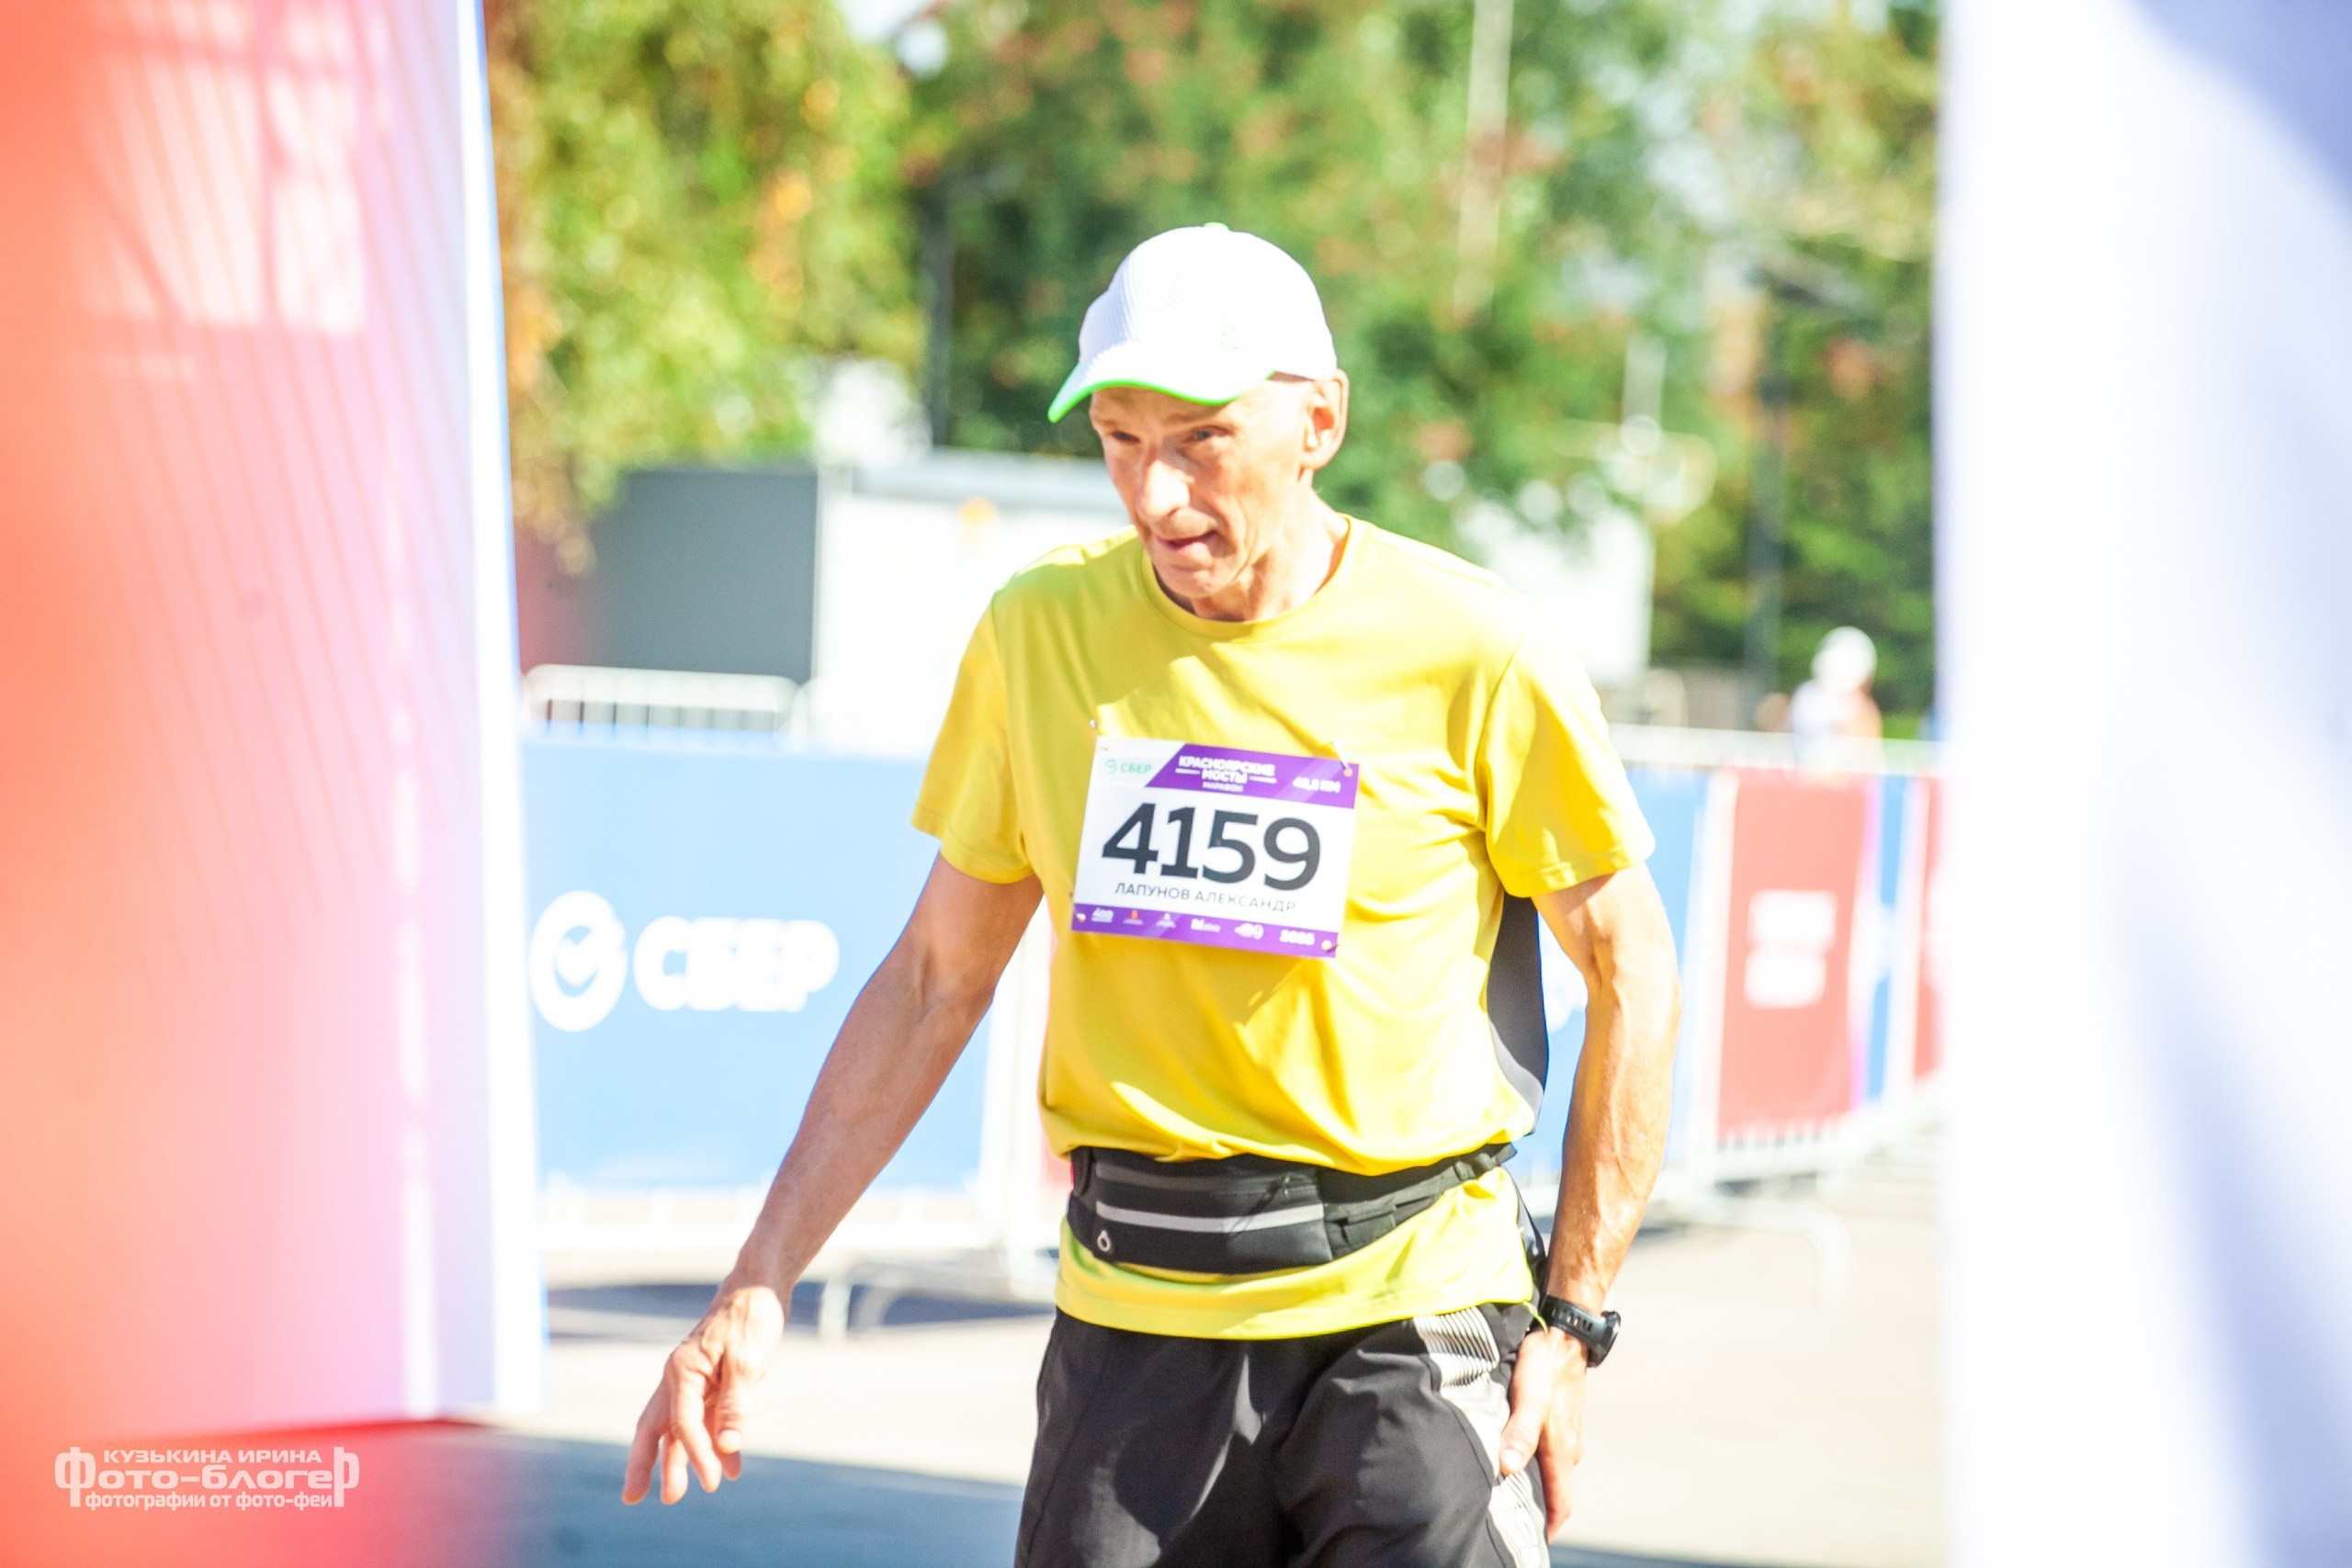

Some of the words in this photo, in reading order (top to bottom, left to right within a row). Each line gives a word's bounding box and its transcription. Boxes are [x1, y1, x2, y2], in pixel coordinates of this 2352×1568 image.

[1120, 762, 1152, 774] СБЕР
[1179, 755, 1275, 777] КРАСНОЯРСКИЕ
[1202, 769, 1248, 784] МОСТЫ
[1102, 802, 1321, 891] 4159
[1114, 882, 1191, 900] ЛАПУНОВ
[1194, 890, 1296, 912] АЛЕКСАНДР
